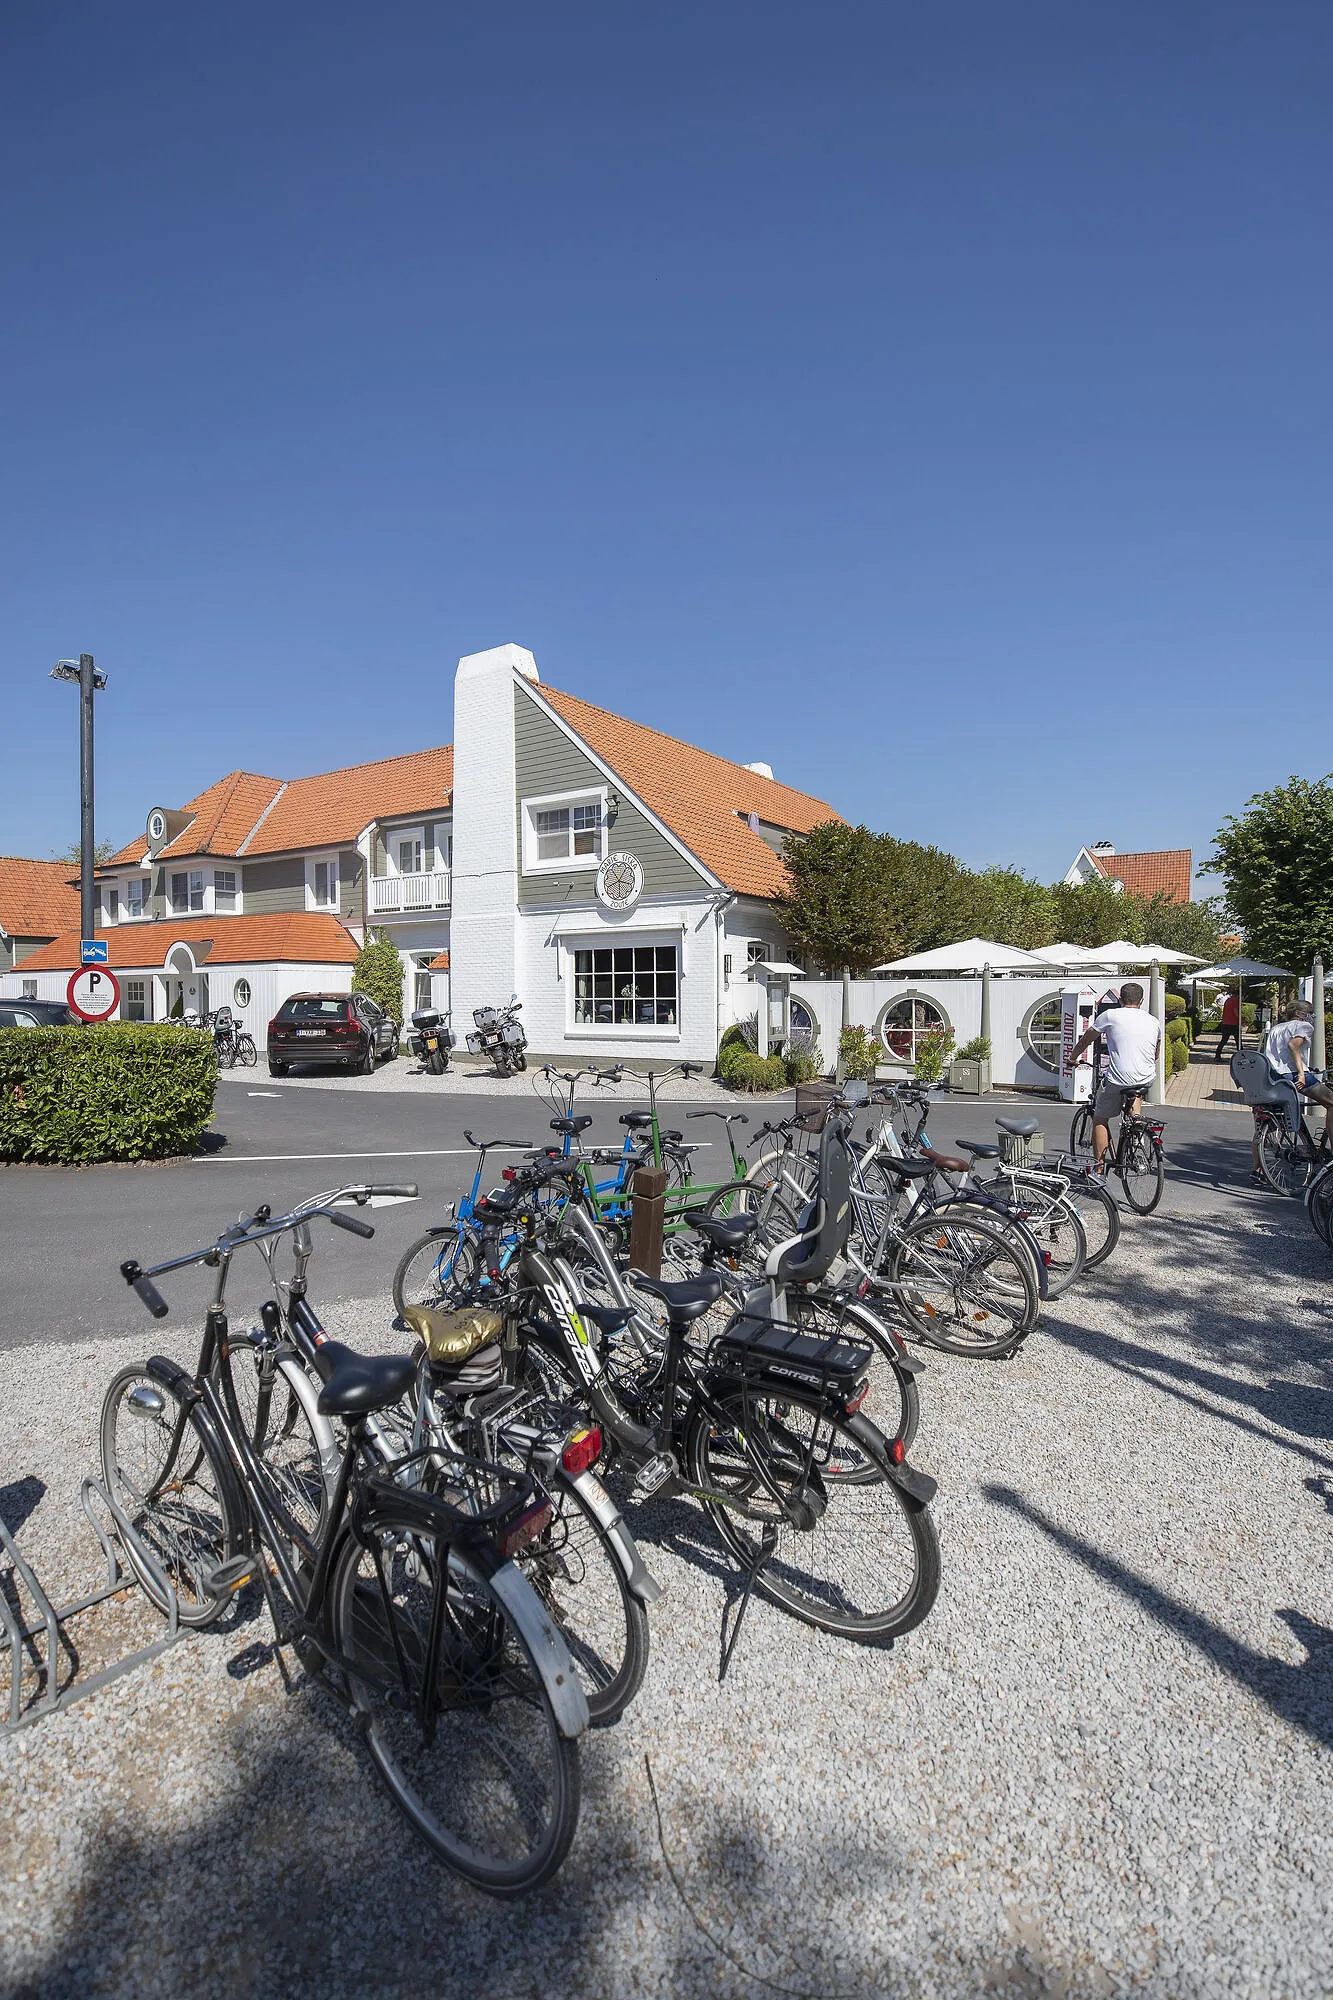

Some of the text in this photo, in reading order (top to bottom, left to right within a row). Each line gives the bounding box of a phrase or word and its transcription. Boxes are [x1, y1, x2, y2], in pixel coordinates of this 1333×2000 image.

[600, 854, 618, 875] MARIE
[610, 899, 630, 908] ZOUTE
[90, 972, 102, 993] P
[1064, 1012, 1075, 1042] ZOUTE
[1062, 1043, 1073, 1078] PEOLE
